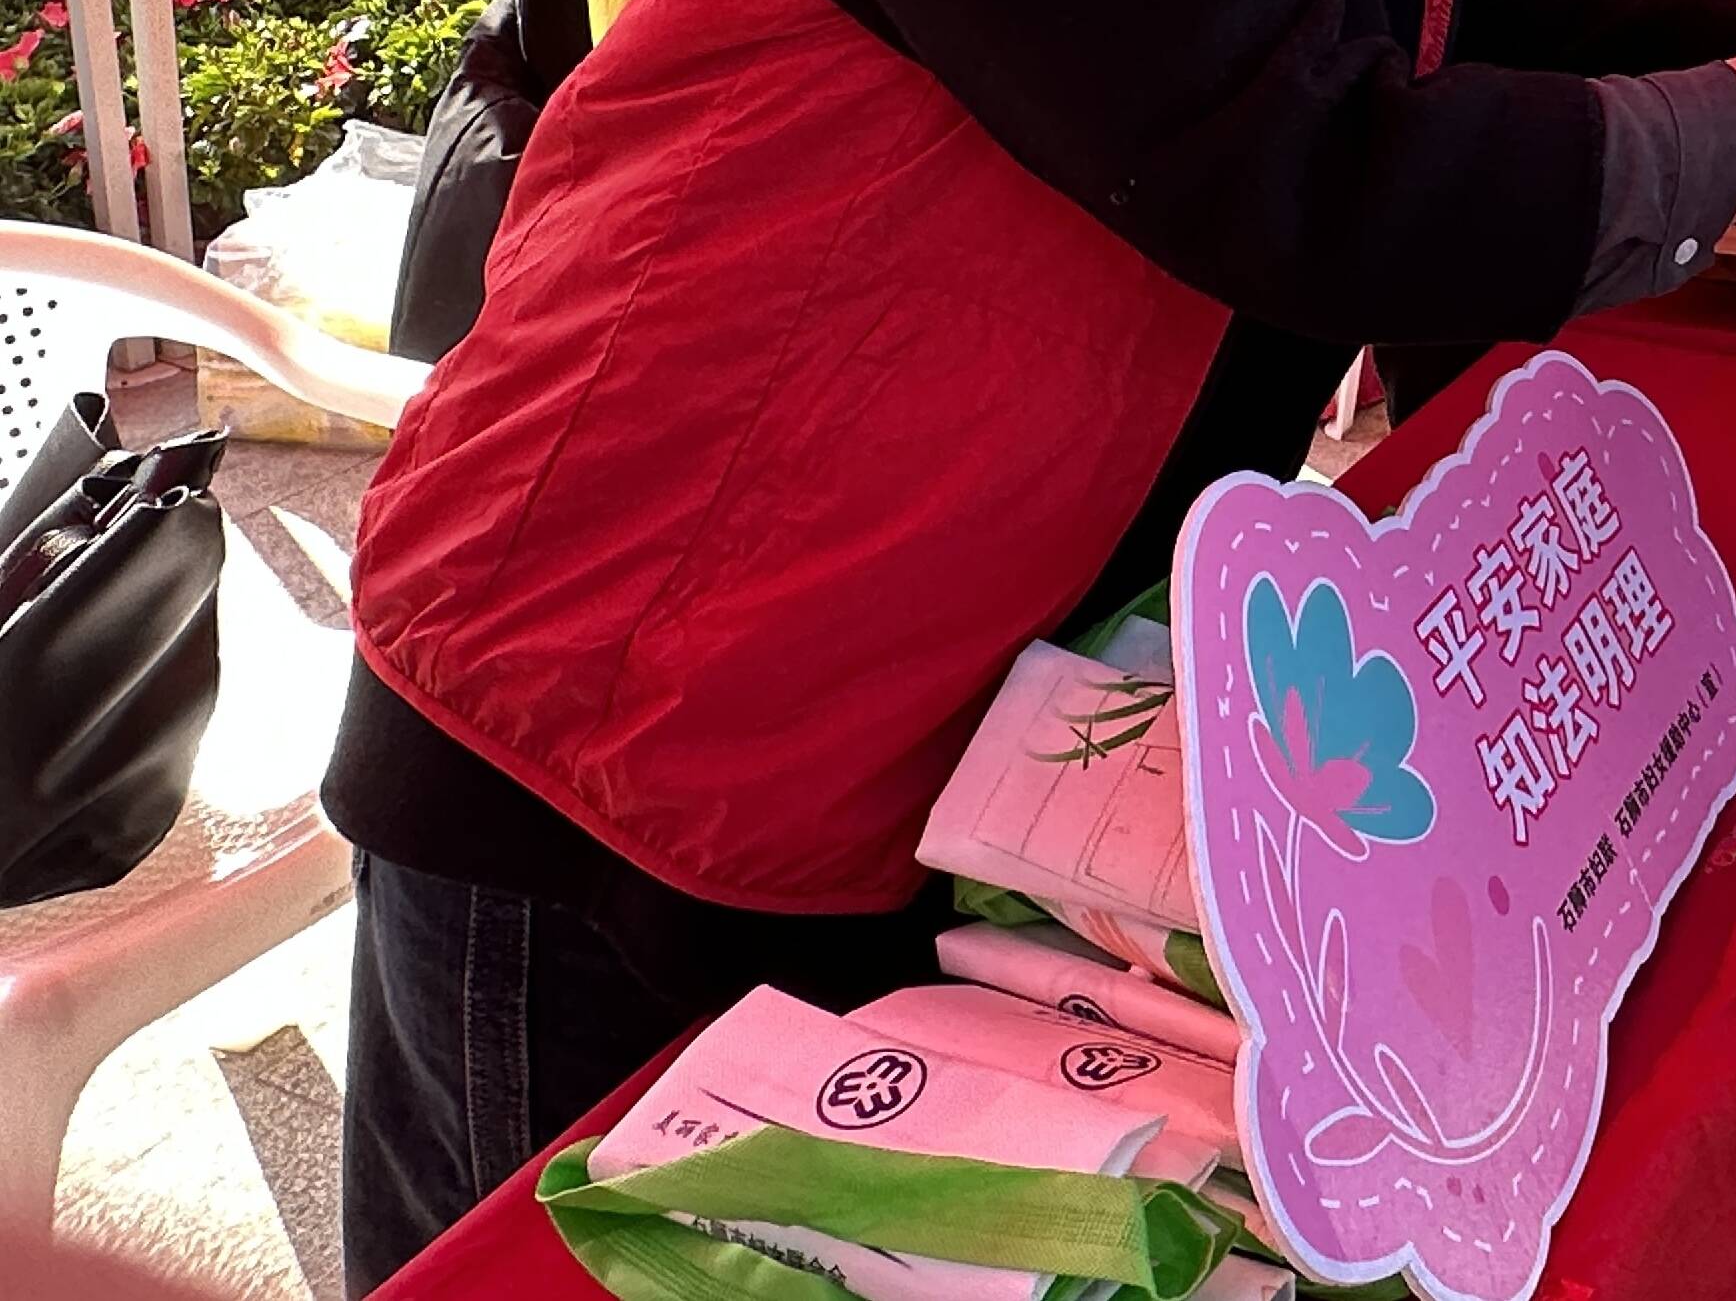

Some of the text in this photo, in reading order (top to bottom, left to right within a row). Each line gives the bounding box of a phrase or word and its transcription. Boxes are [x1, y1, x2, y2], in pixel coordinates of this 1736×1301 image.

[1414, 445, 1623, 706] 平安家庭
[1475, 546, 1676, 848] 知法明理
[1557, 833, 1618, 932] 石狮市妇联
